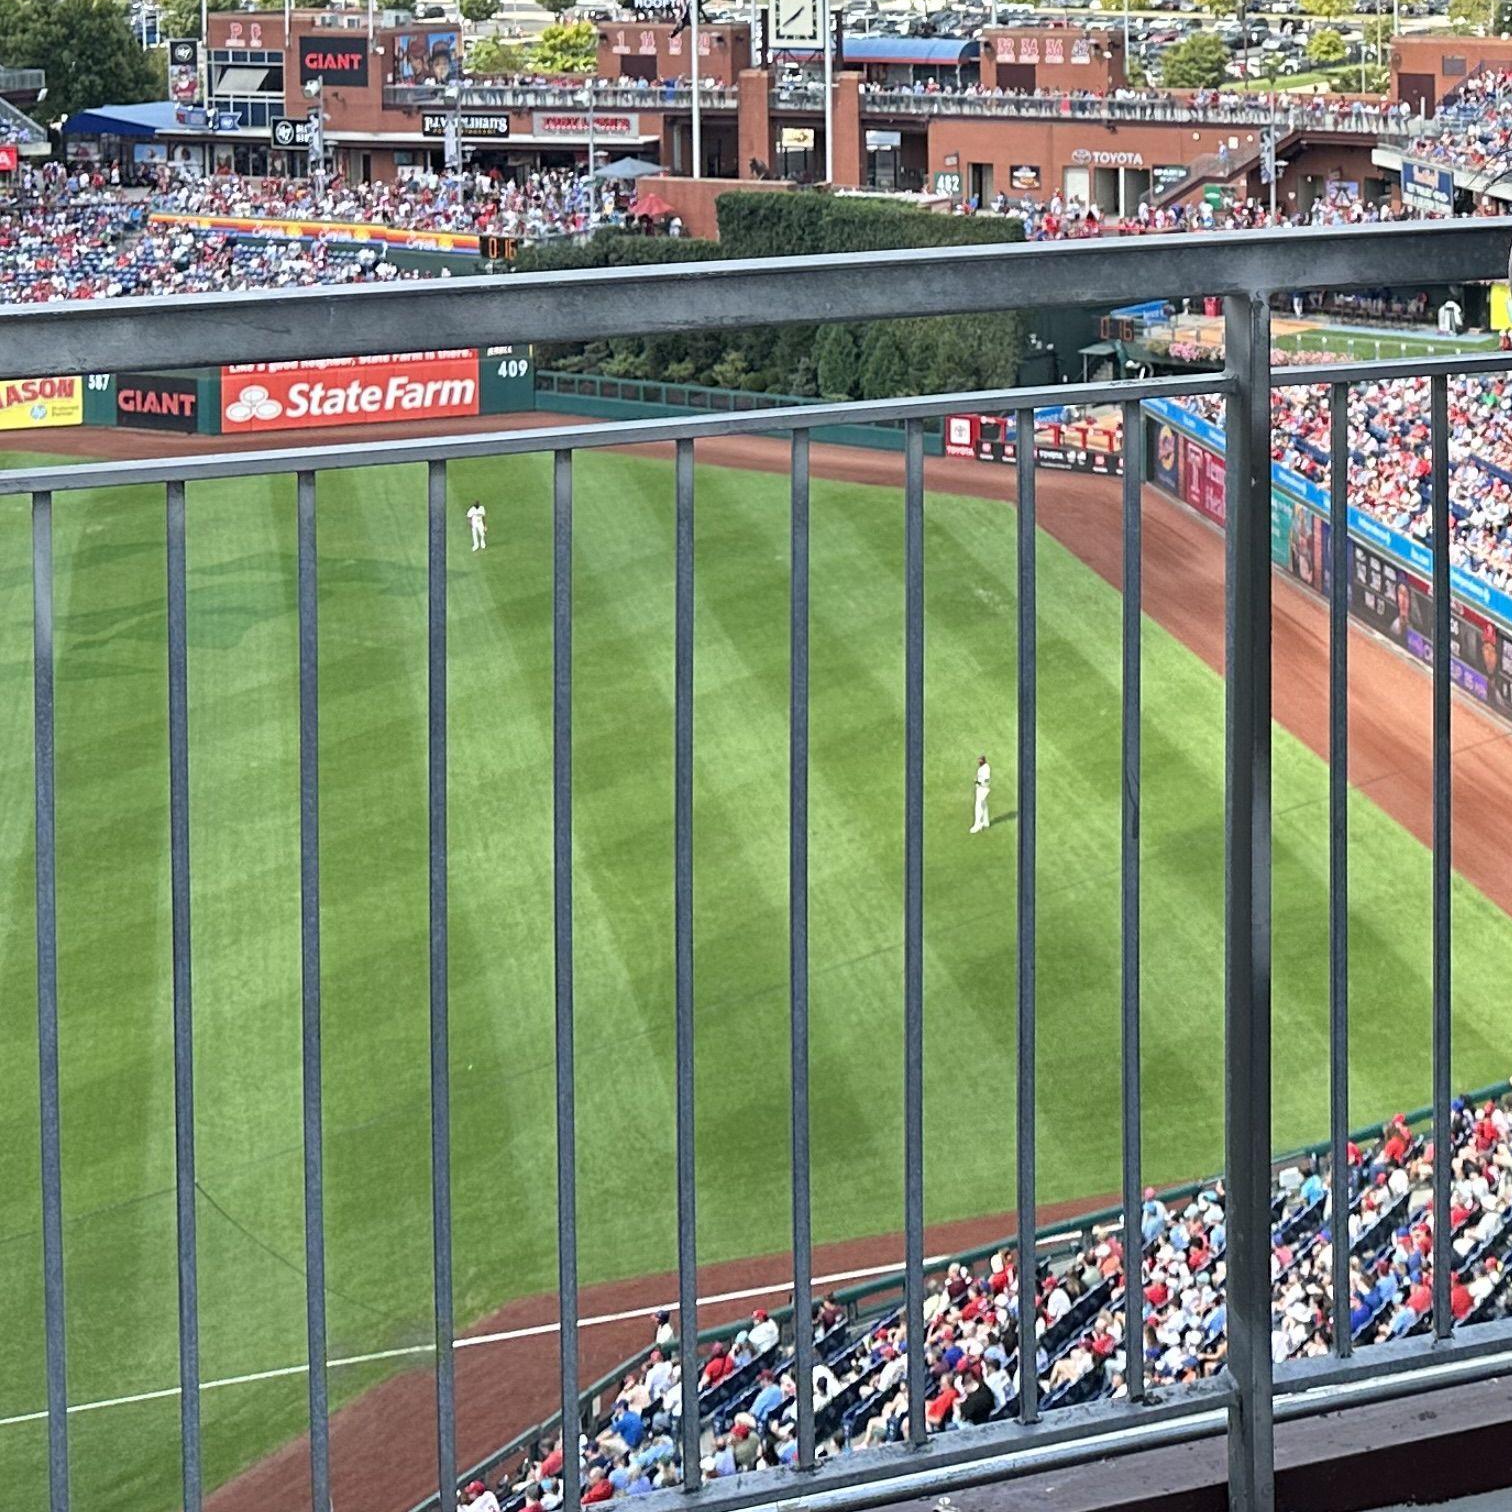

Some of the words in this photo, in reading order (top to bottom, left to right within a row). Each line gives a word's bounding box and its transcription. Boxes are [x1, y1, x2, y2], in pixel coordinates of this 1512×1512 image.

[304, 53, 362, 70] GIANT
[1092, 151, 1143, 165] TOYOTA
[497, 359, 528, 378] 409
[0, 379, 76, 410] ASON
[118, 389, 196, 417] GIANT
